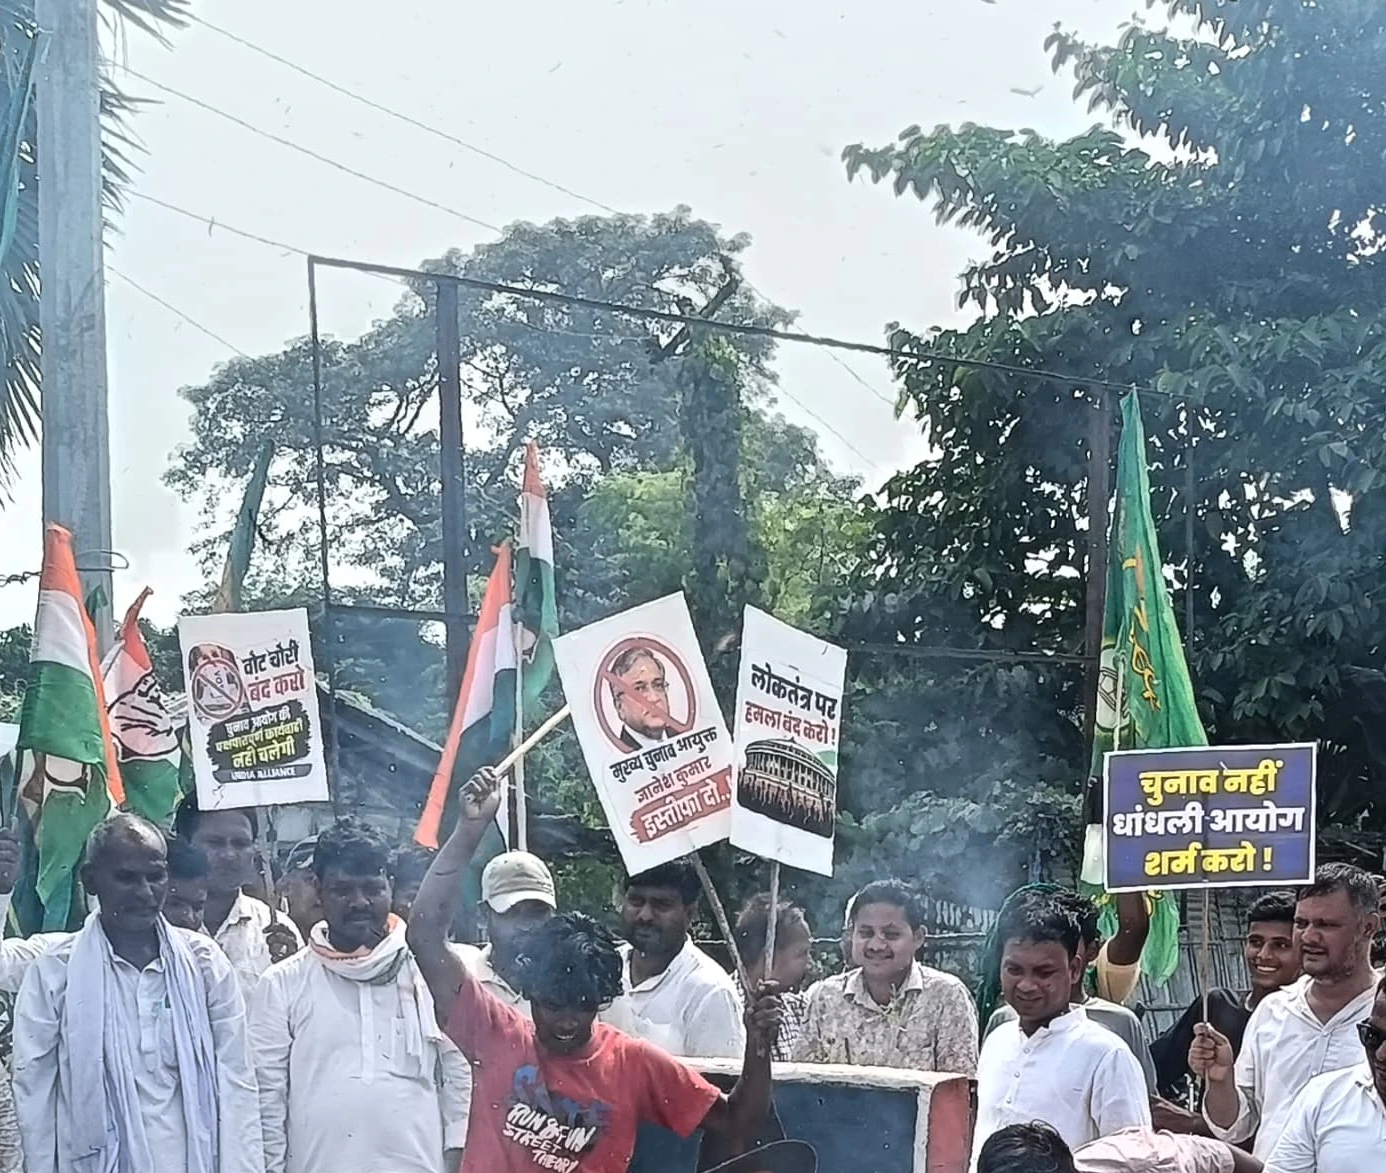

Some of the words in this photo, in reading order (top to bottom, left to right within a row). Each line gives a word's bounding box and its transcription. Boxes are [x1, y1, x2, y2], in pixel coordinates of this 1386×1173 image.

[241, 649, 267, 676] वोट
[267, 637, 300, 668] चोरी
[247, 676, 271, 702] बंद
[272, 663, 305, 696] करो
[751, 662, 814, 712] लोकतंत्र
[814, 691, 838, 720] पर
[745, 701, 782, 730] हमला
[257, 735, 295, 762] चलेगी
[609, 755, 644, 783] मुख्य
[642, 743, 677, 771] चुनाव
[676, 726, 718, 753] आयुक्त
[673, 756, 712, 787] कुमार
[1139, 767, 1219, 805] चुनाव
[1219, 759, 1284, 794] नहीं
[1113, 801, 1205, 837] धांधली
[1207, 800, 1305, 834] आयोग
[1144, 842, 1202, 876] शर्म
[507, 1102, 547, 1131] RUN
[502, 1122, 562, 1154] STREET
